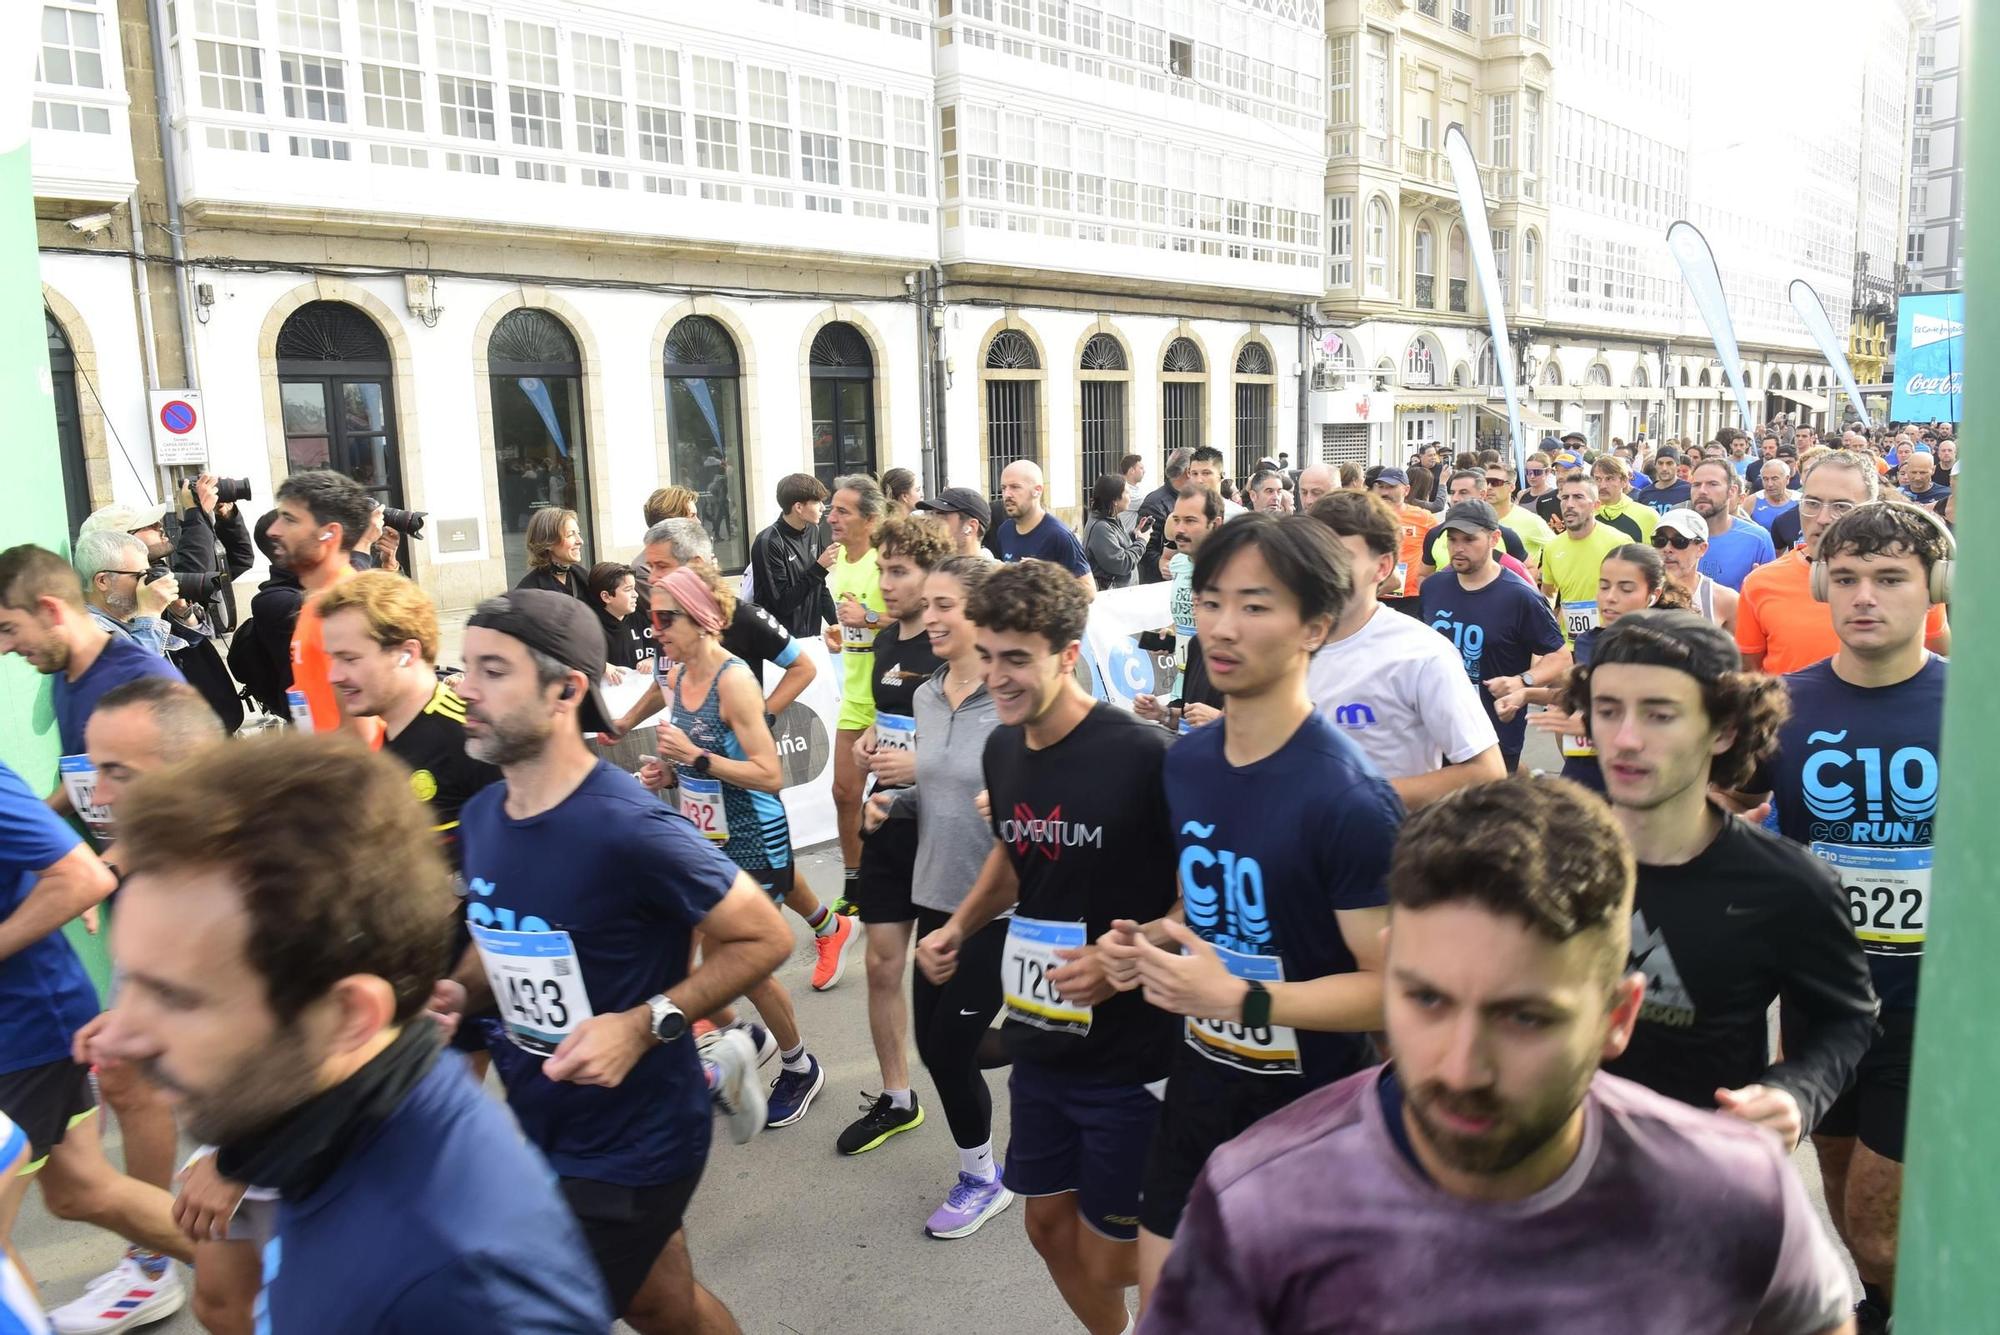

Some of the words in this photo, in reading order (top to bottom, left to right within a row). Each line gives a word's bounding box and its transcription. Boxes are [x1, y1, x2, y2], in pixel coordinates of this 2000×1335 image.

[1905, 372, 1963, 395] Coca-Co
[1569, 615, 1590, 632] 260
[1846, 885, 1923, 930] 622
